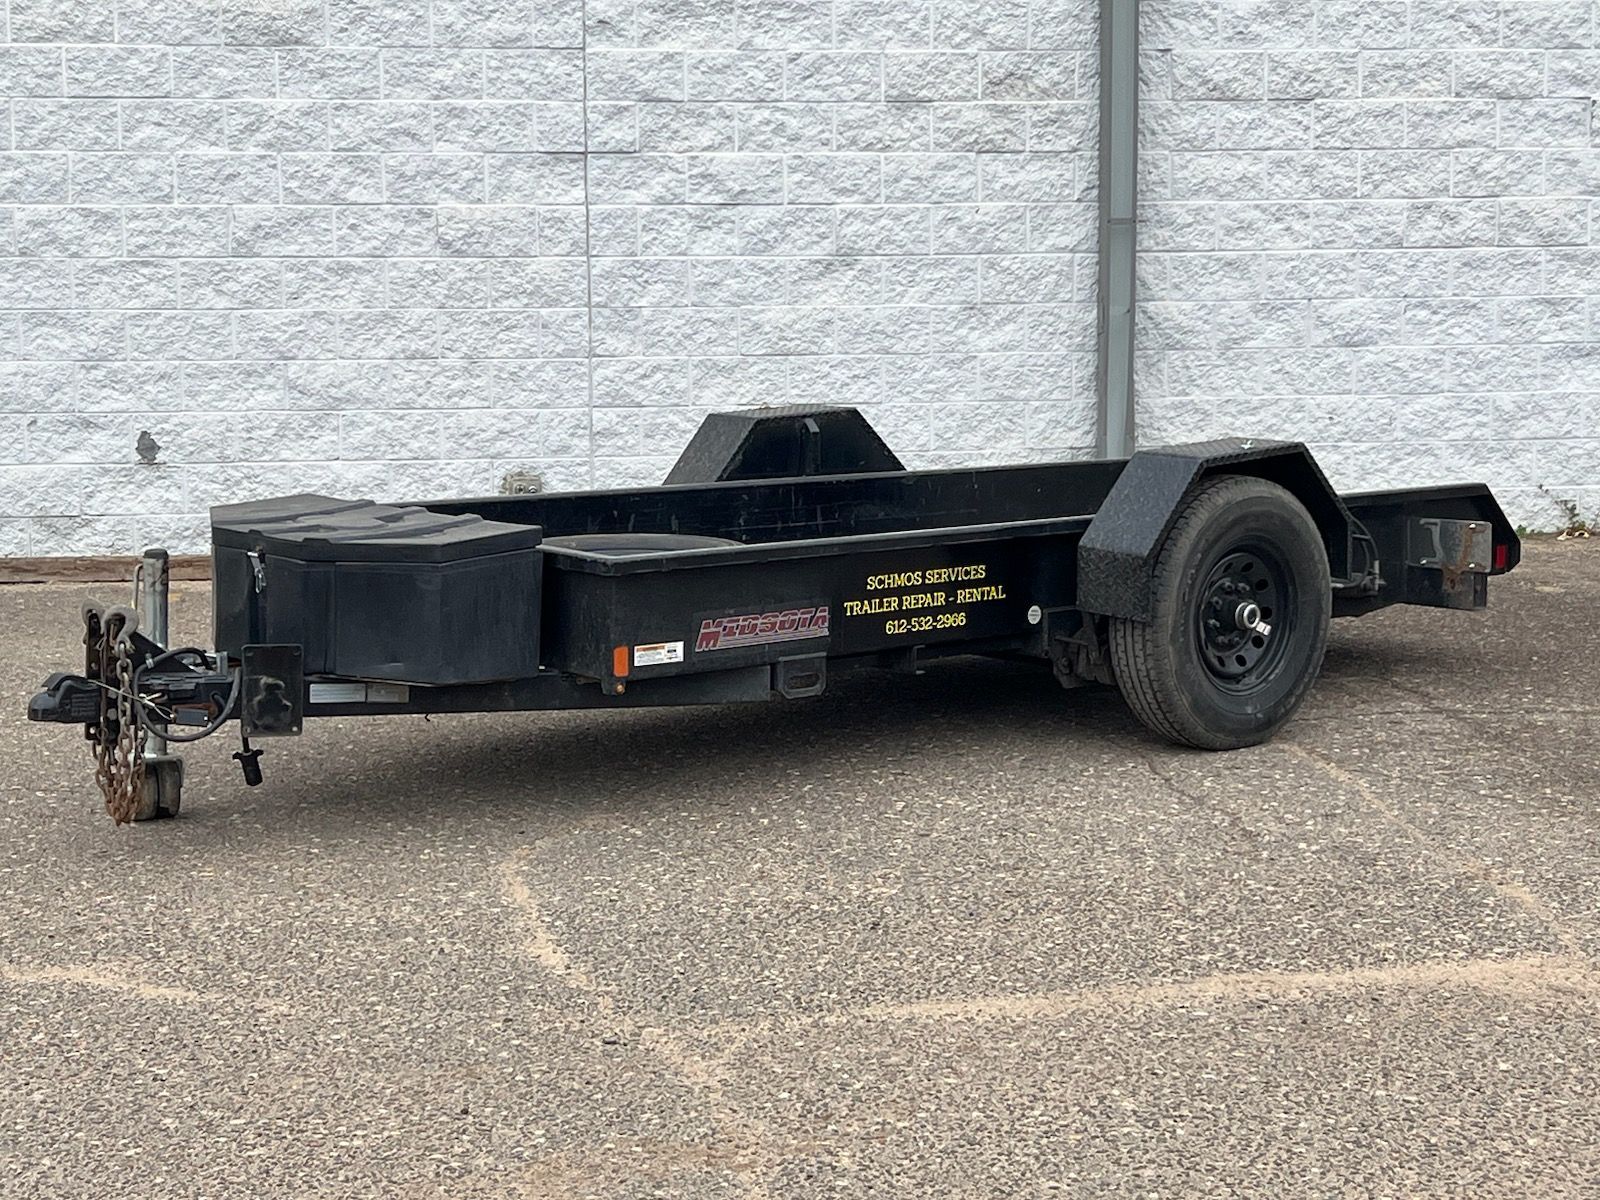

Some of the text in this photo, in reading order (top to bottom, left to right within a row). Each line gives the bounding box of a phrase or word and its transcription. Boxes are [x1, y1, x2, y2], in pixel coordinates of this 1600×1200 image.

[866, 565, 987, 590] SCHMOS SERVICES
[844, 596, 899, 616] TRAILER
[902, 592, 946, 610] REPAIR
[956, 586, 1006, 604] RENTAL
[695, 606, 829, 652] MIDSOTA
[885, 612, 967, 634] 612-532-2966
